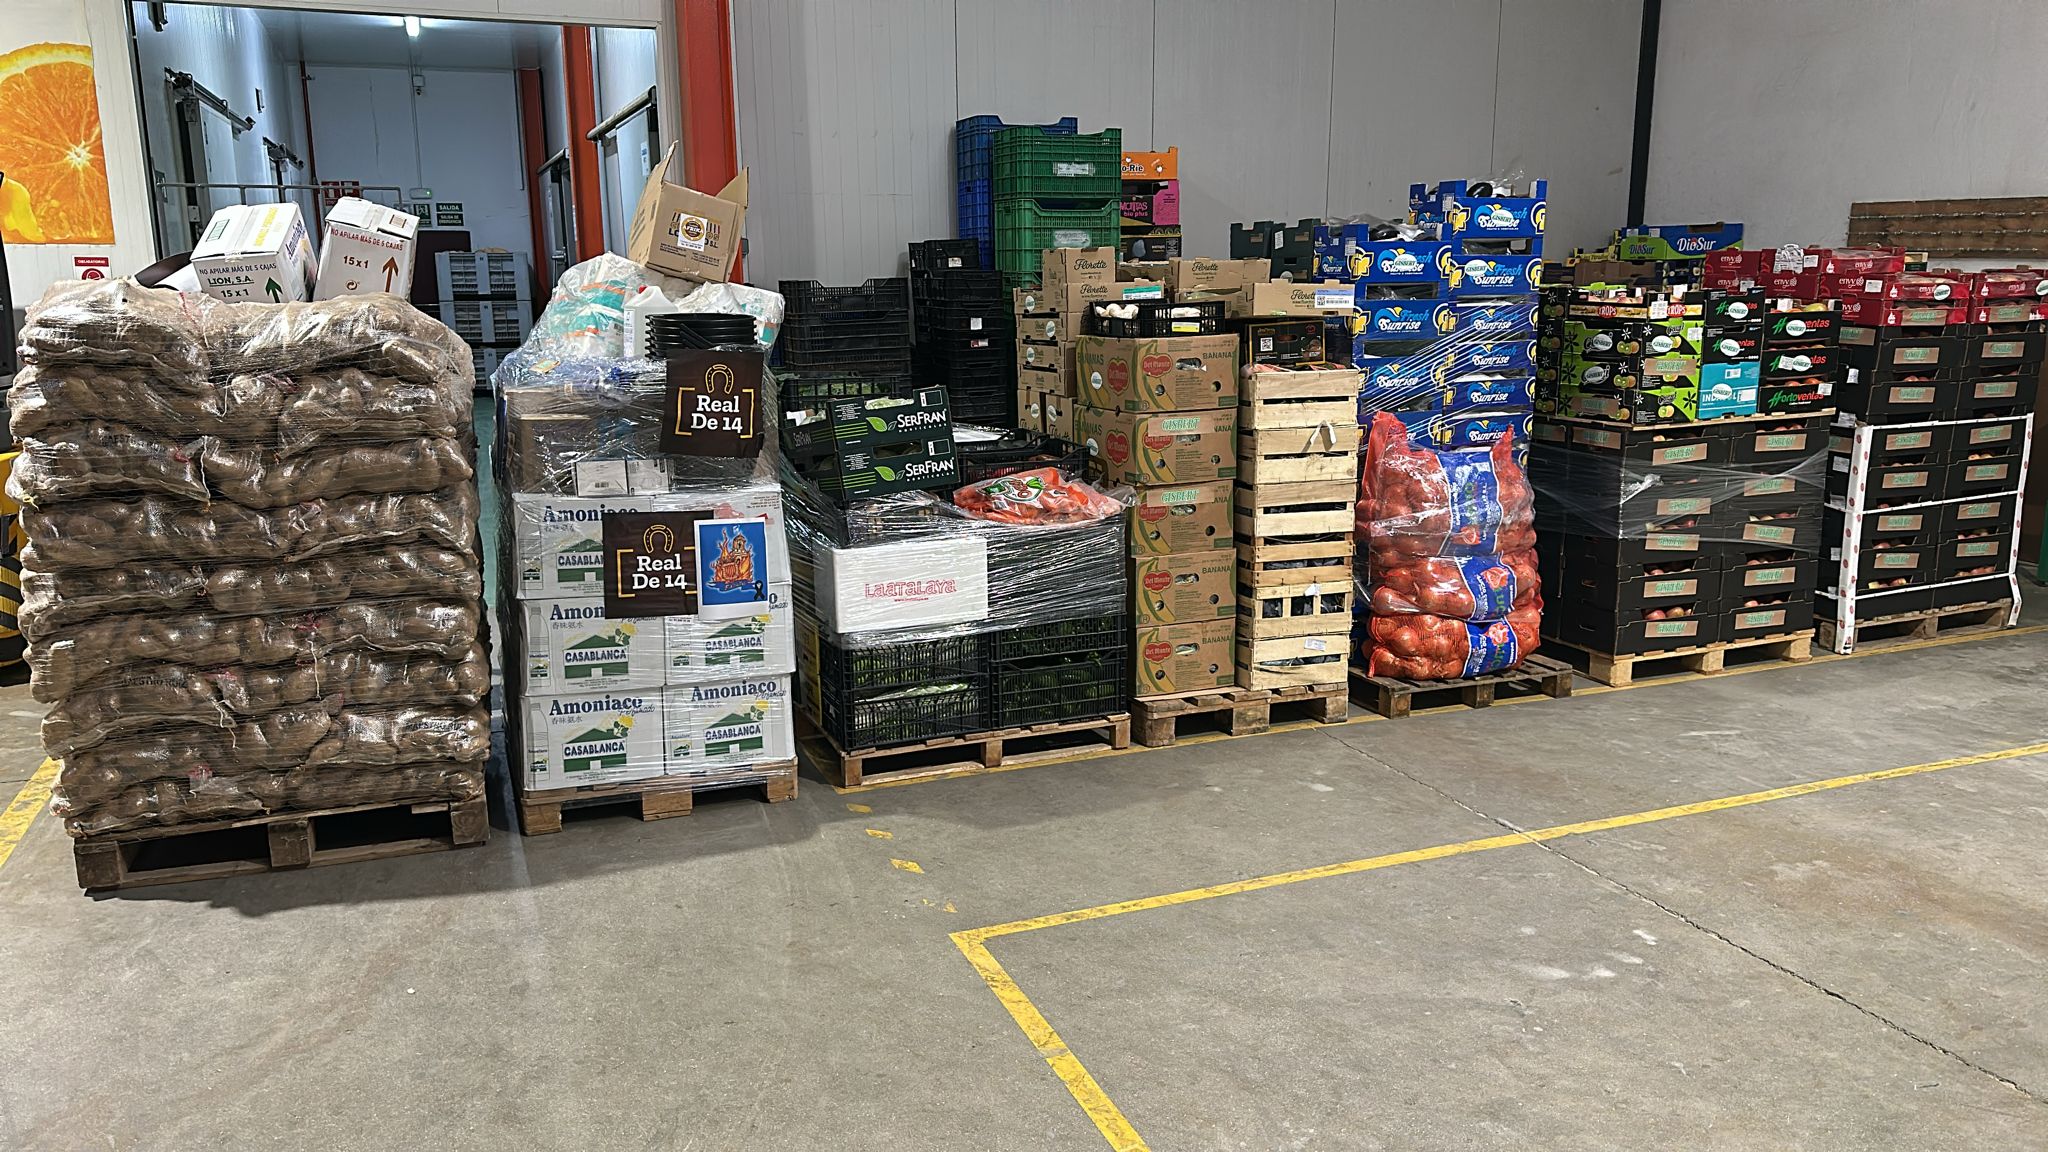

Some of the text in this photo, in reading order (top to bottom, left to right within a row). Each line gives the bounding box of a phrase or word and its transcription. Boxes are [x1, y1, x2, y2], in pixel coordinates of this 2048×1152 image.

[331, 228, 338, 236] NO
[1629, 244, 1655, 255] DioSur
[1676, 237, 1717, 251] DioSur
[343, 255, 355, 265] 15
[363, 259, 369, 268] 1
[1074, 258, 1107, 270] Florette
[1191, 261, 1219, 272] Florette
[1720, 256, 1735, 265] envy
[210, 267, 230, 275] APILAR
[260, 262, 277, 271] CAJAS
[1494, 263, 1523, 276] Fresh
[1472, 273, 1515, 285] Sunrise
[1774, 278, 1790, 288] envy
[1839, 277, 1855, 288] envy
[221, 290, 233, 298] 15
[1080, 283, 1109, 294] Florette
[1400, 309, 1430, 321] Fresh
[1667, 306, 1686, 315] TROPS
[1378, 317, 1421, 331] Sunrise
[1473, 318, 1512, 330] Sunrise
[1472, 354, 1510, 366] Sunrise
[1376, 375, 1419, 388] Sunrise
[696, 393, 740, 414] Real
[1470, 391, 1509, 403] Sunrise
[691, 412, 744, 435] De 14
[1161, 417, 1200, 431] GISBERT
[1161, 489, 1199, 503] GISBERT
[636, 553, 682, 572] Real
[632, 573, 688, 591] De 14
[706, 637, 762, 651] CASABLANCA
[565, 649, 627, 664] CASABLANCA
[691, 680, 778, 702] Amoniaco
[549, 695, 644, 716] Amoniaco
[705, 724, 761, 741] CASABLANCA
[564, 742, 625, 757] CASABLANCA
